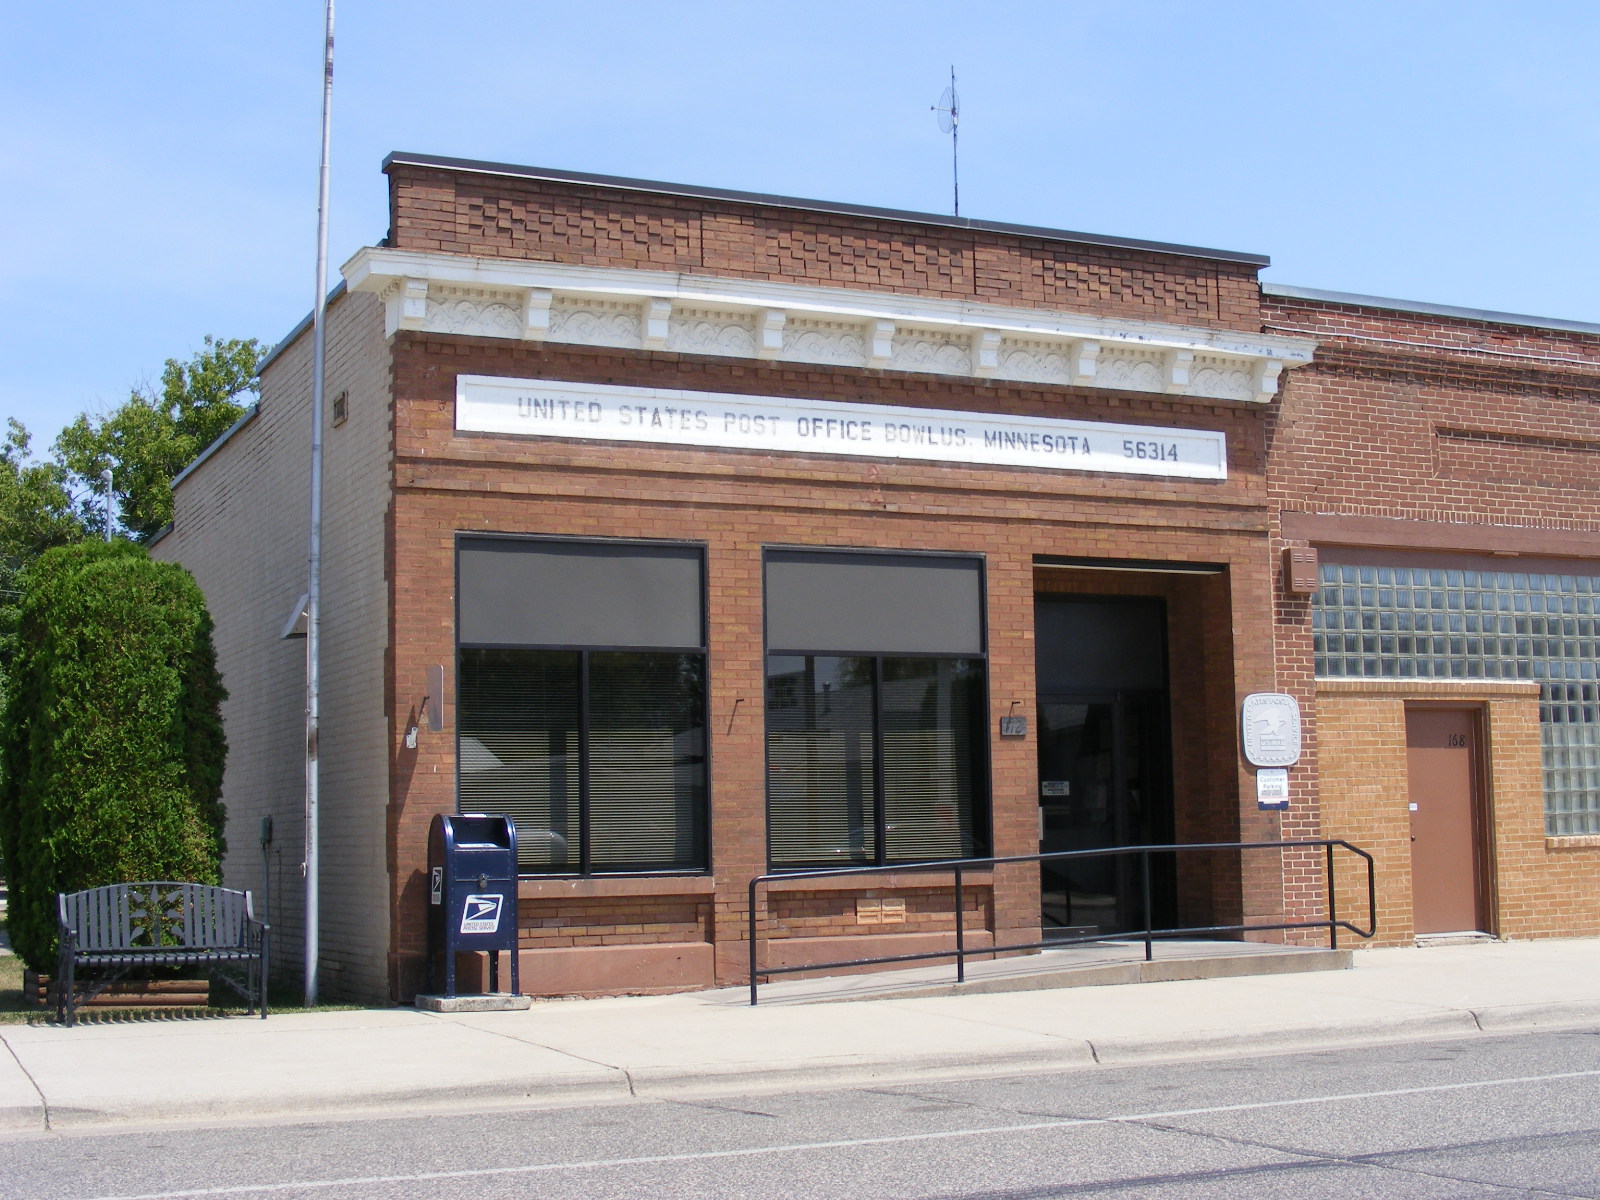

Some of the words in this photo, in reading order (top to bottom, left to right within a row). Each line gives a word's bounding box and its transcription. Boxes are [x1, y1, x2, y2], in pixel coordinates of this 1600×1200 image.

[517, 396, 602, 423] UNITED
[619, 404, 708, 430] STATES
[723, 411, 781, 436] POST
[797, 416, 872, 441] OFFICE
[984, 429, 1092, 456] MINNESOTA
[1123, 440, 1179, 462] 56314
[1448, 733, 1466, 747] 168
[1263, 783, 1283, 791] Parking
